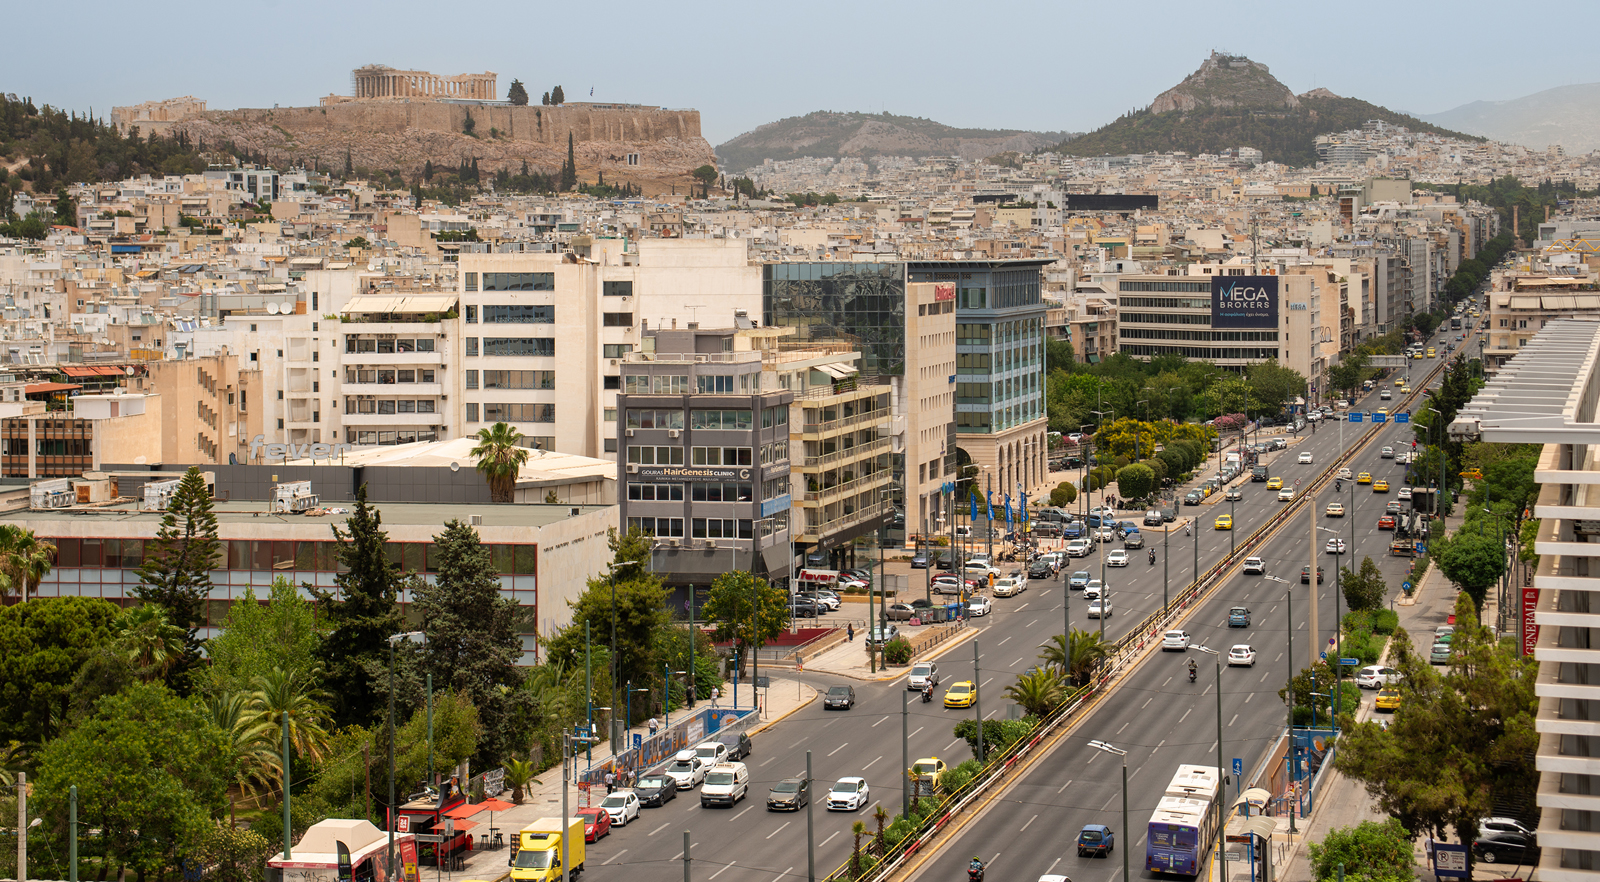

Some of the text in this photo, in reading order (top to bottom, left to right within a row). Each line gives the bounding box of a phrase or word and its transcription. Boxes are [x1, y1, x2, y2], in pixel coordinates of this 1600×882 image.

[1219, 280, 1270, 301] MEGA
[249, 434, 352, 460] fever
[800, 570, 835, 581] fever
[1525, 602, 1536, 655] GENERALI
